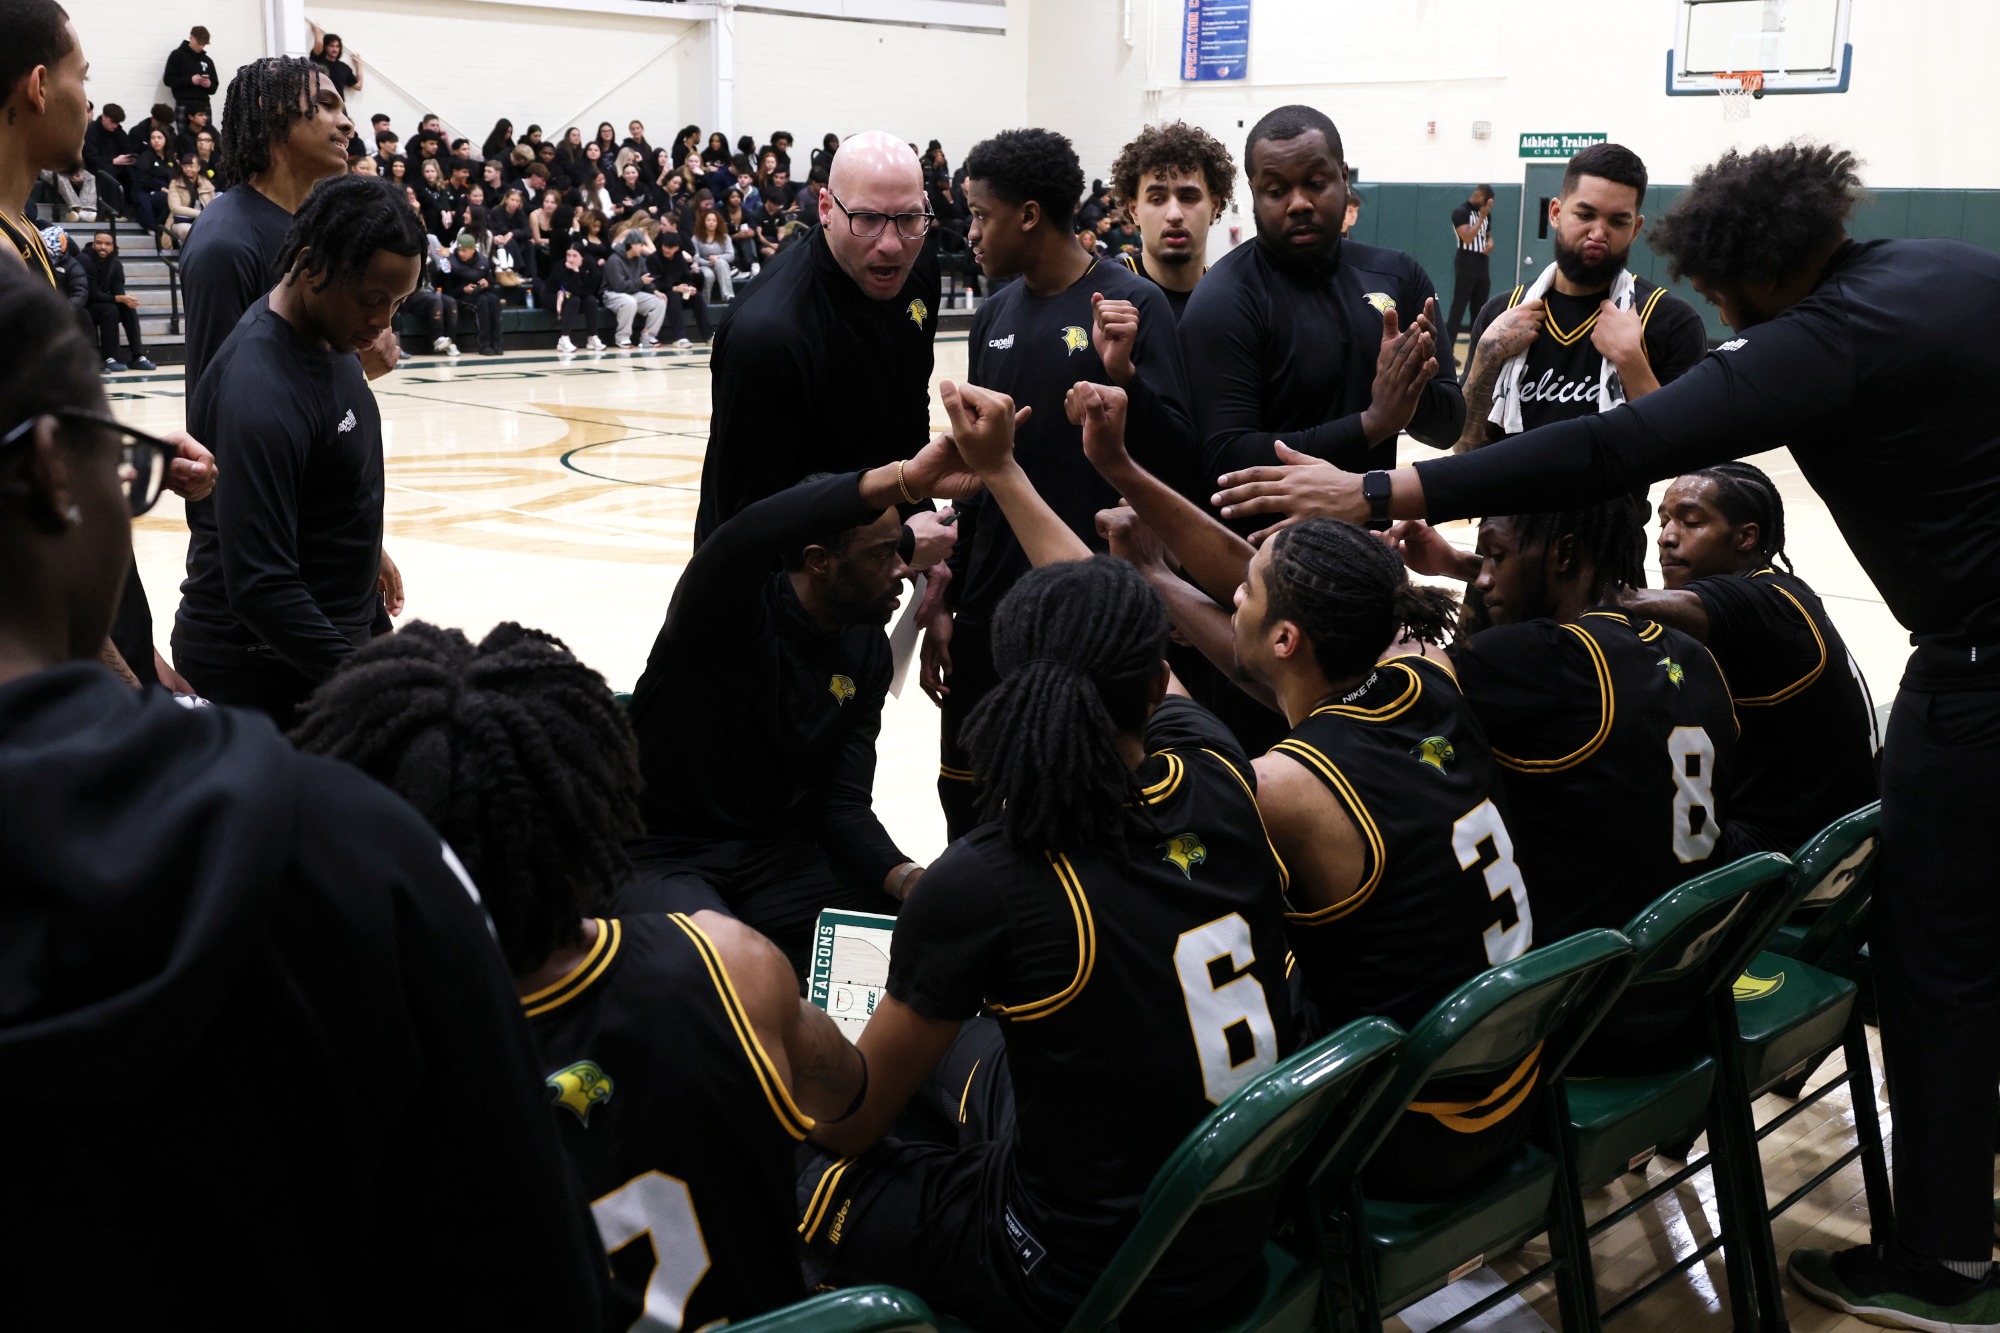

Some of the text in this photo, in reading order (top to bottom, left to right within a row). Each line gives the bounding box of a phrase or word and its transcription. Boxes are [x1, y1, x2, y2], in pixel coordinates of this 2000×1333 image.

[1185, 11, 1200, 79] SPECTATOR
[1521, 135, 1559, 148] Athletic
[989, 334, 1014, 349] capelli
[1519, 365, 1600, 403] elicia
[1342, 672, 1379, 704] NIKE PR
[1666, 726, 1721, 864] 8
[1452, 797, 1534, 969] 3
[813, 926, 834, 999] FALCONS
[1172, 911, 1279, 1107] 6
[829, 1198, 851, 1245] capelli
